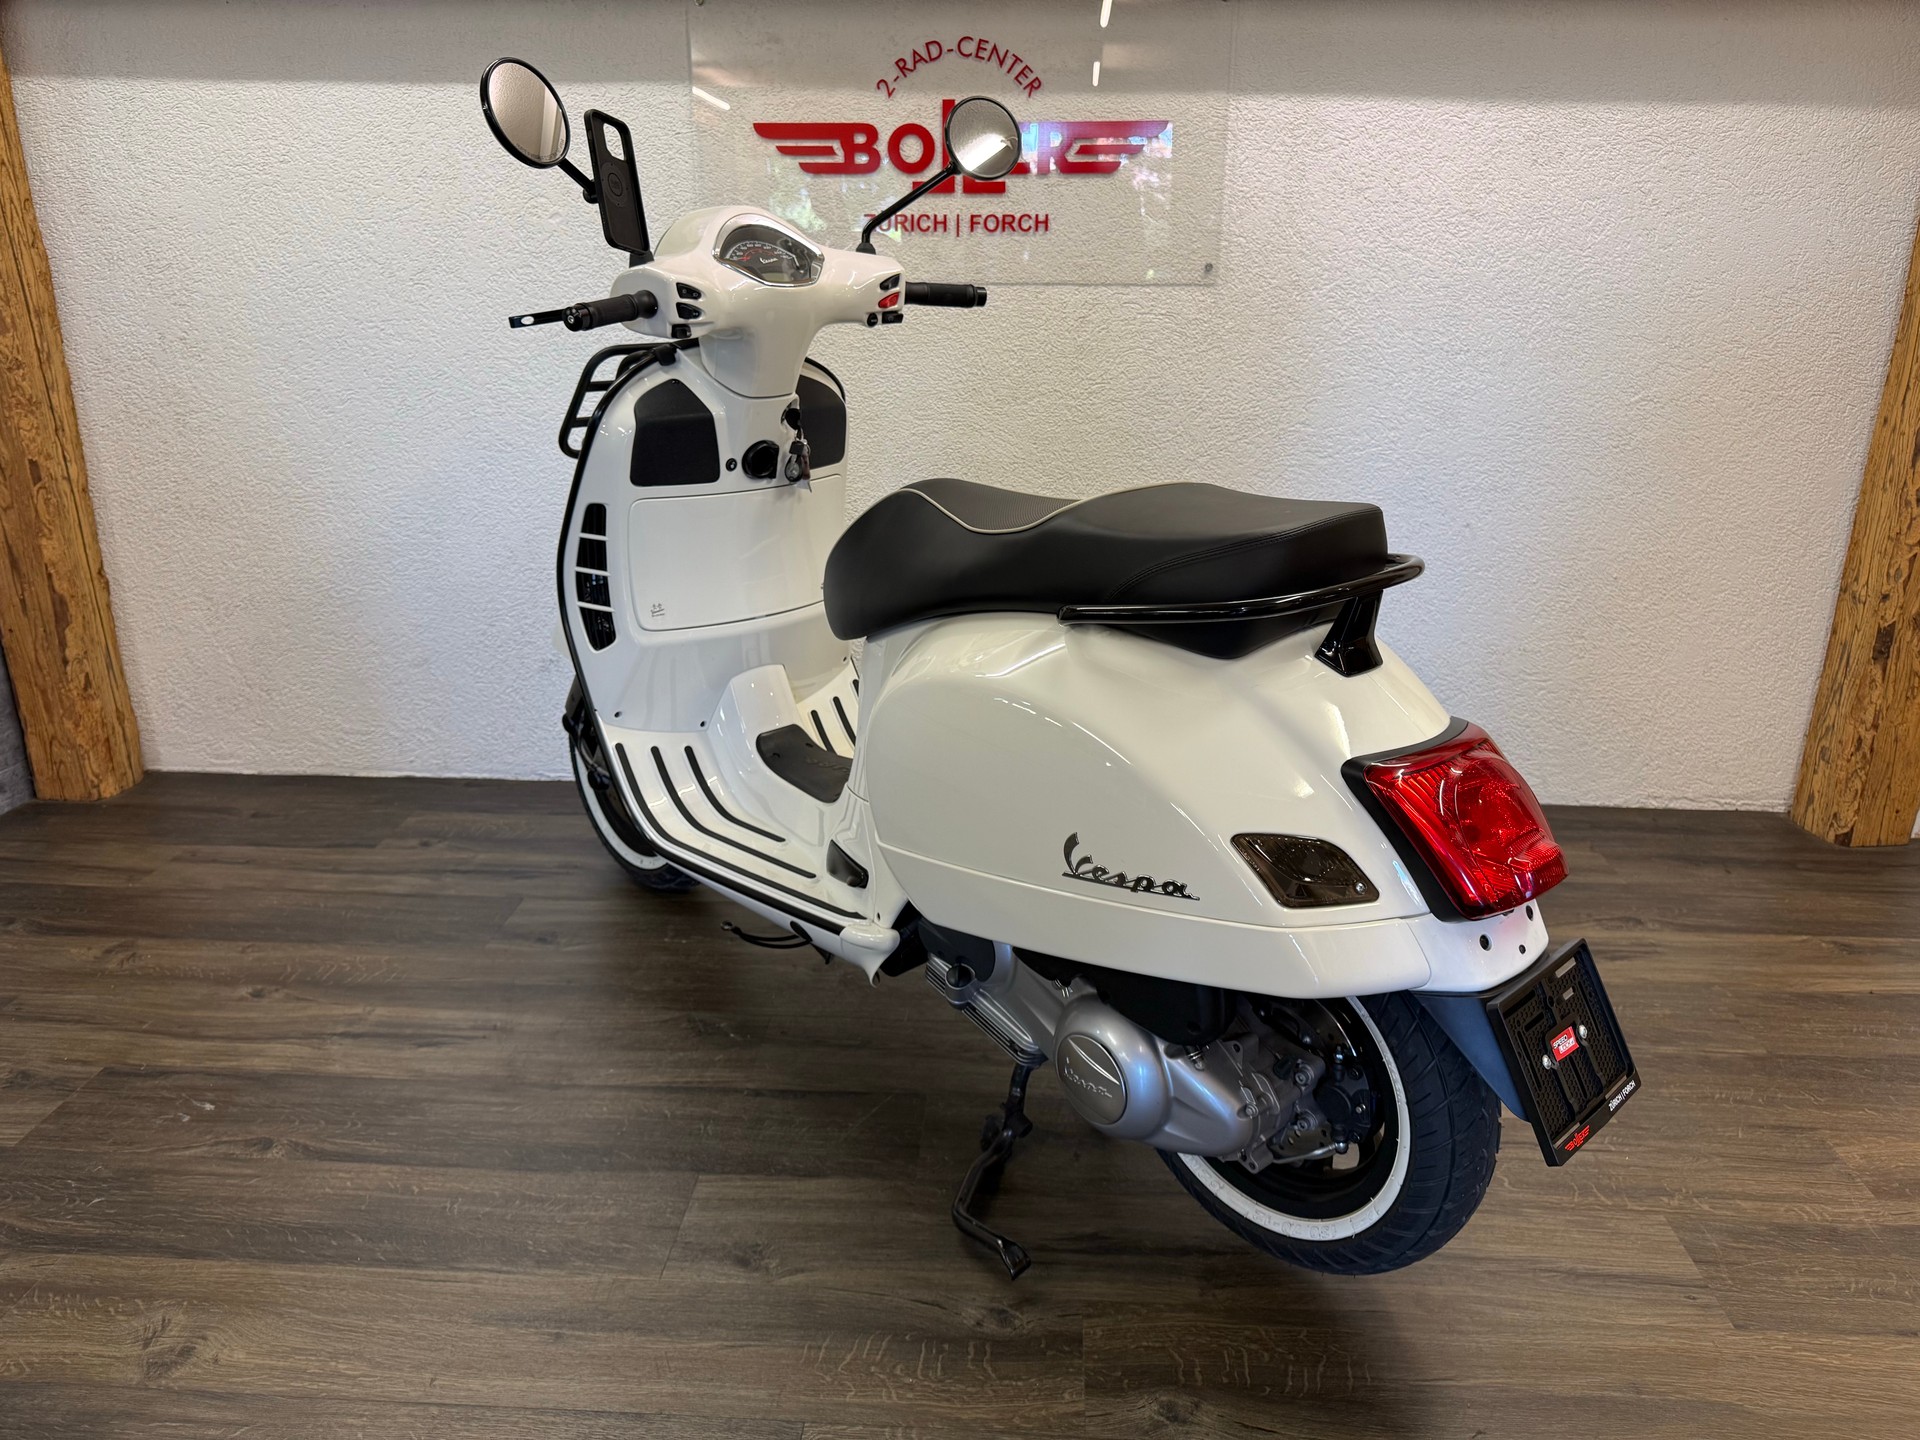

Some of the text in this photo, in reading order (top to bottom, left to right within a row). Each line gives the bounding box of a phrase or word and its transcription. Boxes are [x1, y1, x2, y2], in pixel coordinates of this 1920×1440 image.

[876, 36, 1043, 98] 2-RAD-CENTER
[969, 213, 1050, 233] FORCH
[1062, 832, 1200, 901] Vespa
